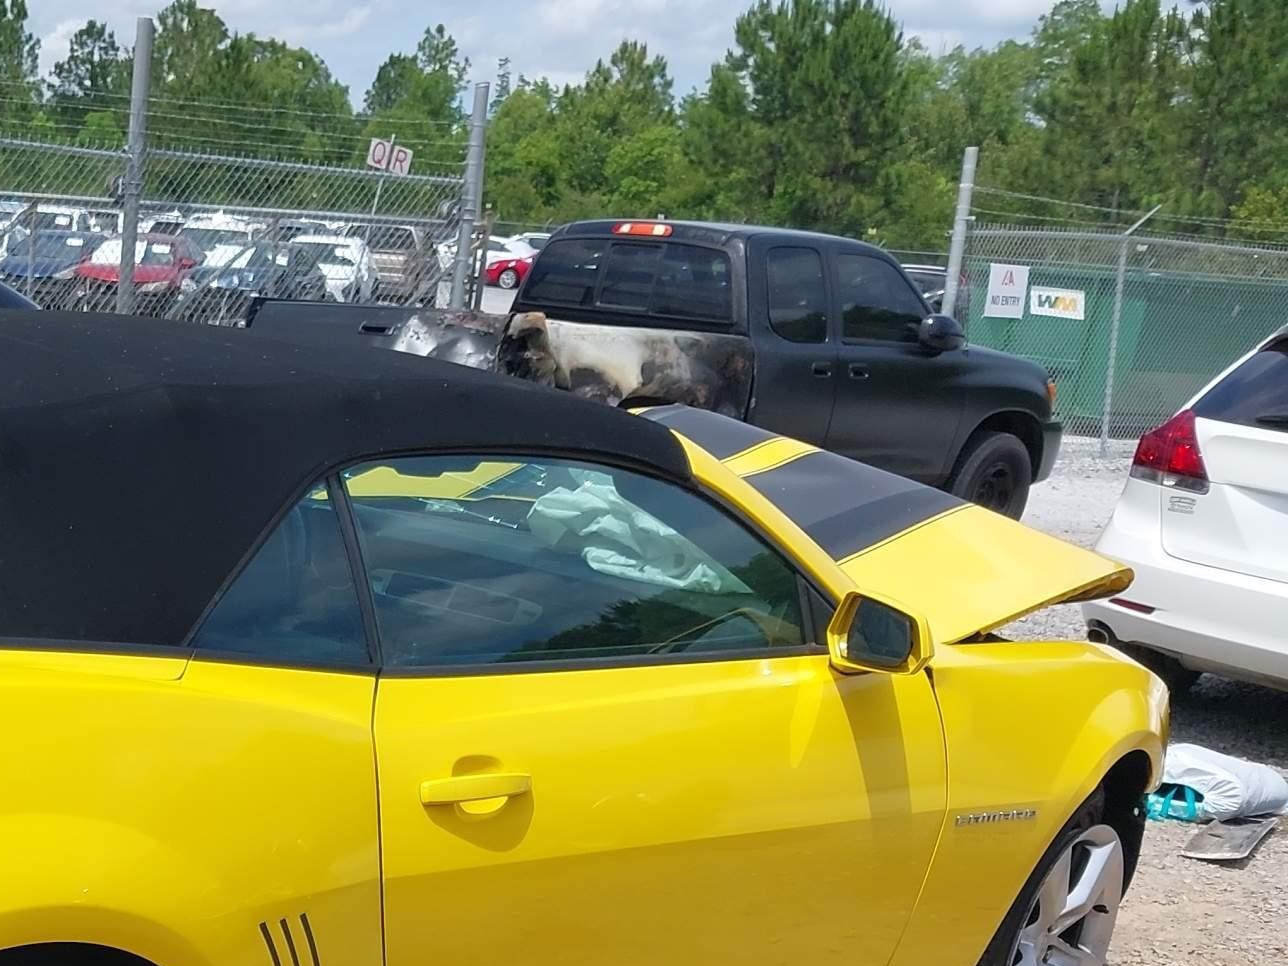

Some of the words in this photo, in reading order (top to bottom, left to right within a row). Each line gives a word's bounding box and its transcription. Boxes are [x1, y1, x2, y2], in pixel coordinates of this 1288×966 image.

[372, 141, 386, 167] Q
[392, 149, 408, 174] R
[991, 295, 1000, 305] NO
[1001, 295, 1021, 306] ENTRY
[1037, 294, 1077, 312] WM
